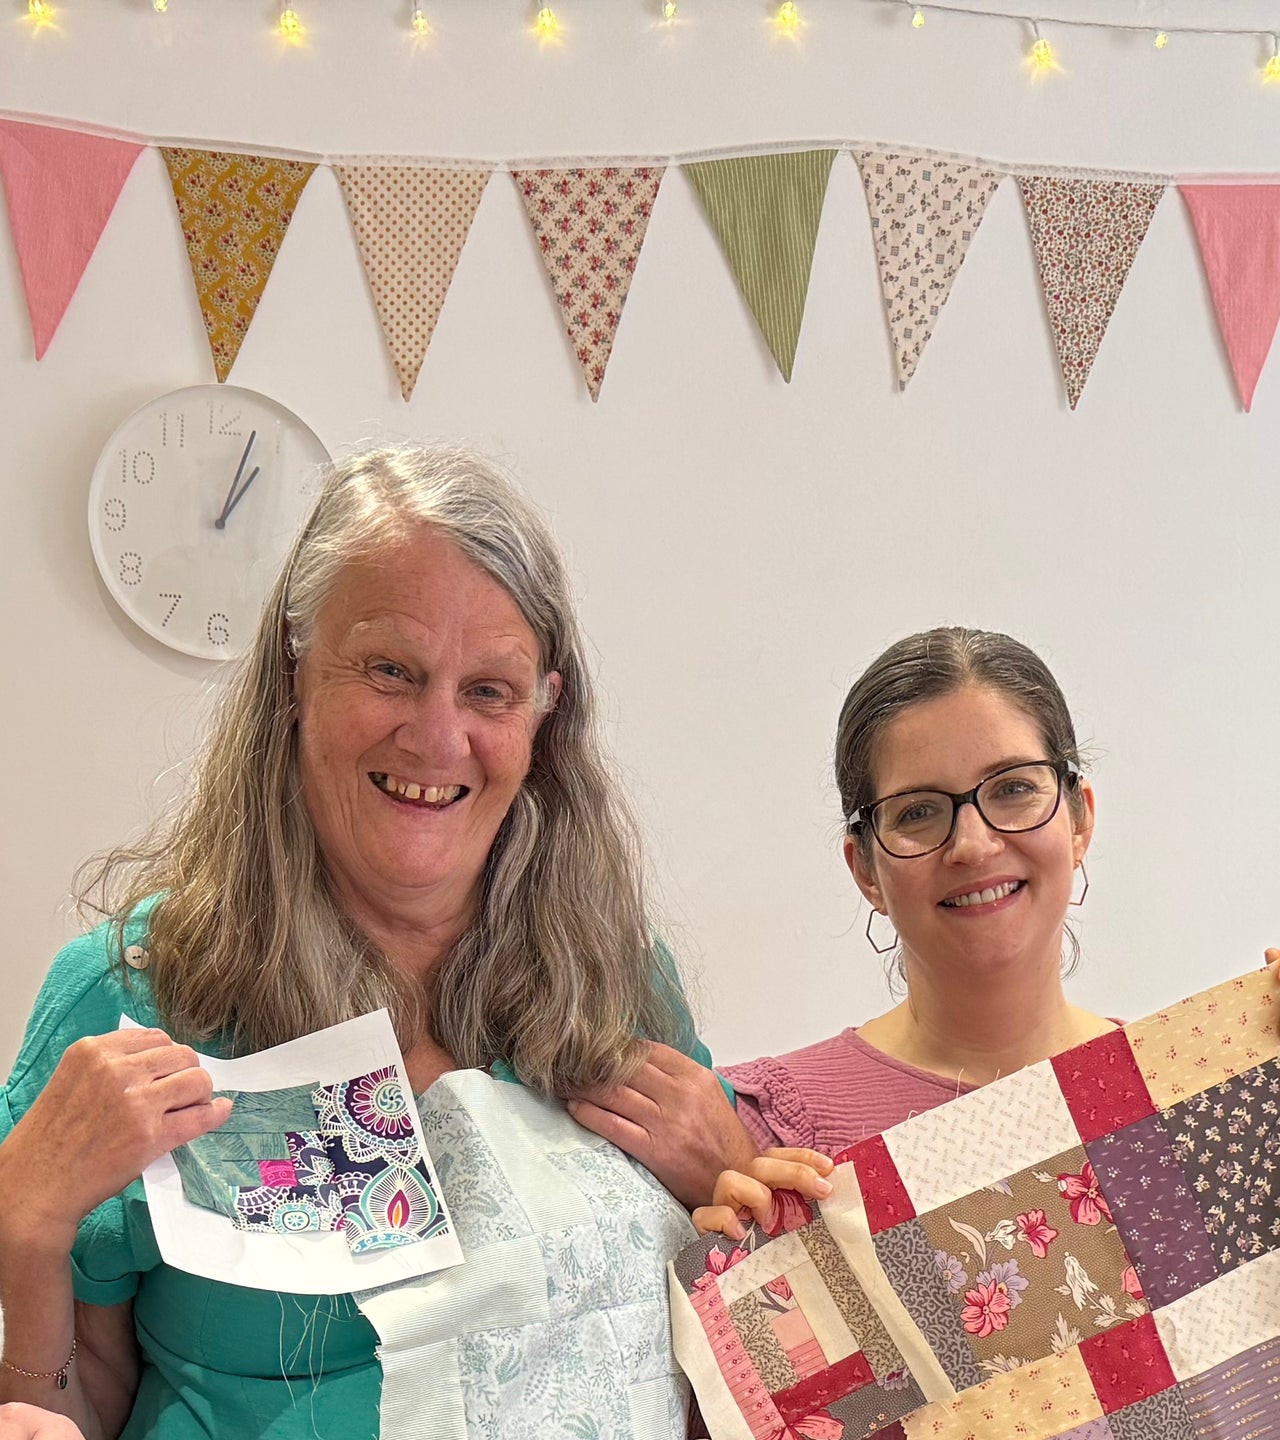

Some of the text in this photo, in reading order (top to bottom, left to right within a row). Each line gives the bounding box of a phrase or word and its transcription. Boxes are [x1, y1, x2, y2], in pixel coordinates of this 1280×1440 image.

[159, 412, 184, 448] 11
[119, 449, 155, 484] 10
[104, 498, 126, 532] 9
[119, 552, 142, 586] 8
[159, 593, 182, 627] 7
[207, 613, 229, 645] 6
